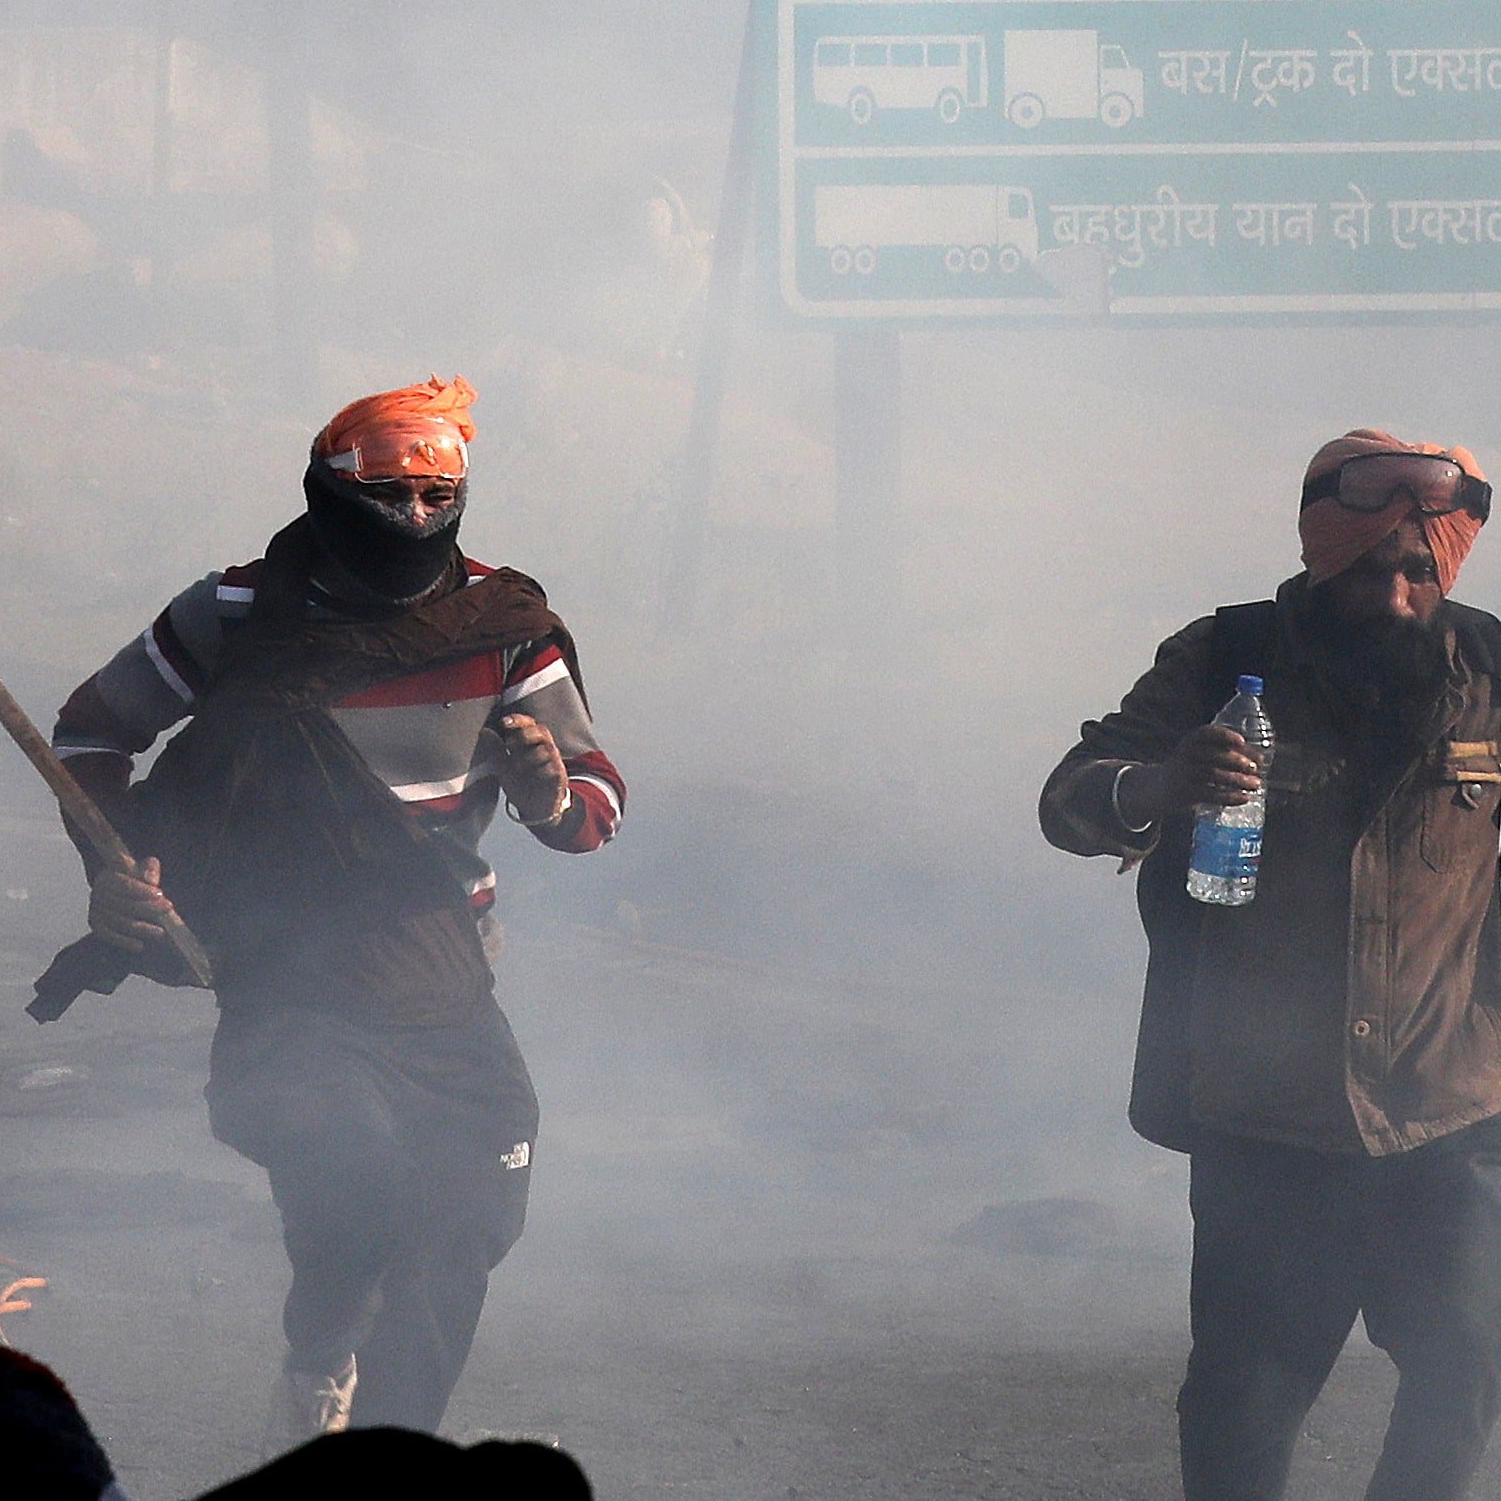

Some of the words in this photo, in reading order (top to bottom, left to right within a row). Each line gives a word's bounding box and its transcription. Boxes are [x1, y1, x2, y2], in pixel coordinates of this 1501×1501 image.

[1159, 38, 1317, 108] बस/ट्रक
[1331, 30, 1373, 94] दो
[1234, 199, 1318, 248] यान
[1330, 183, 1373, 247] दो
